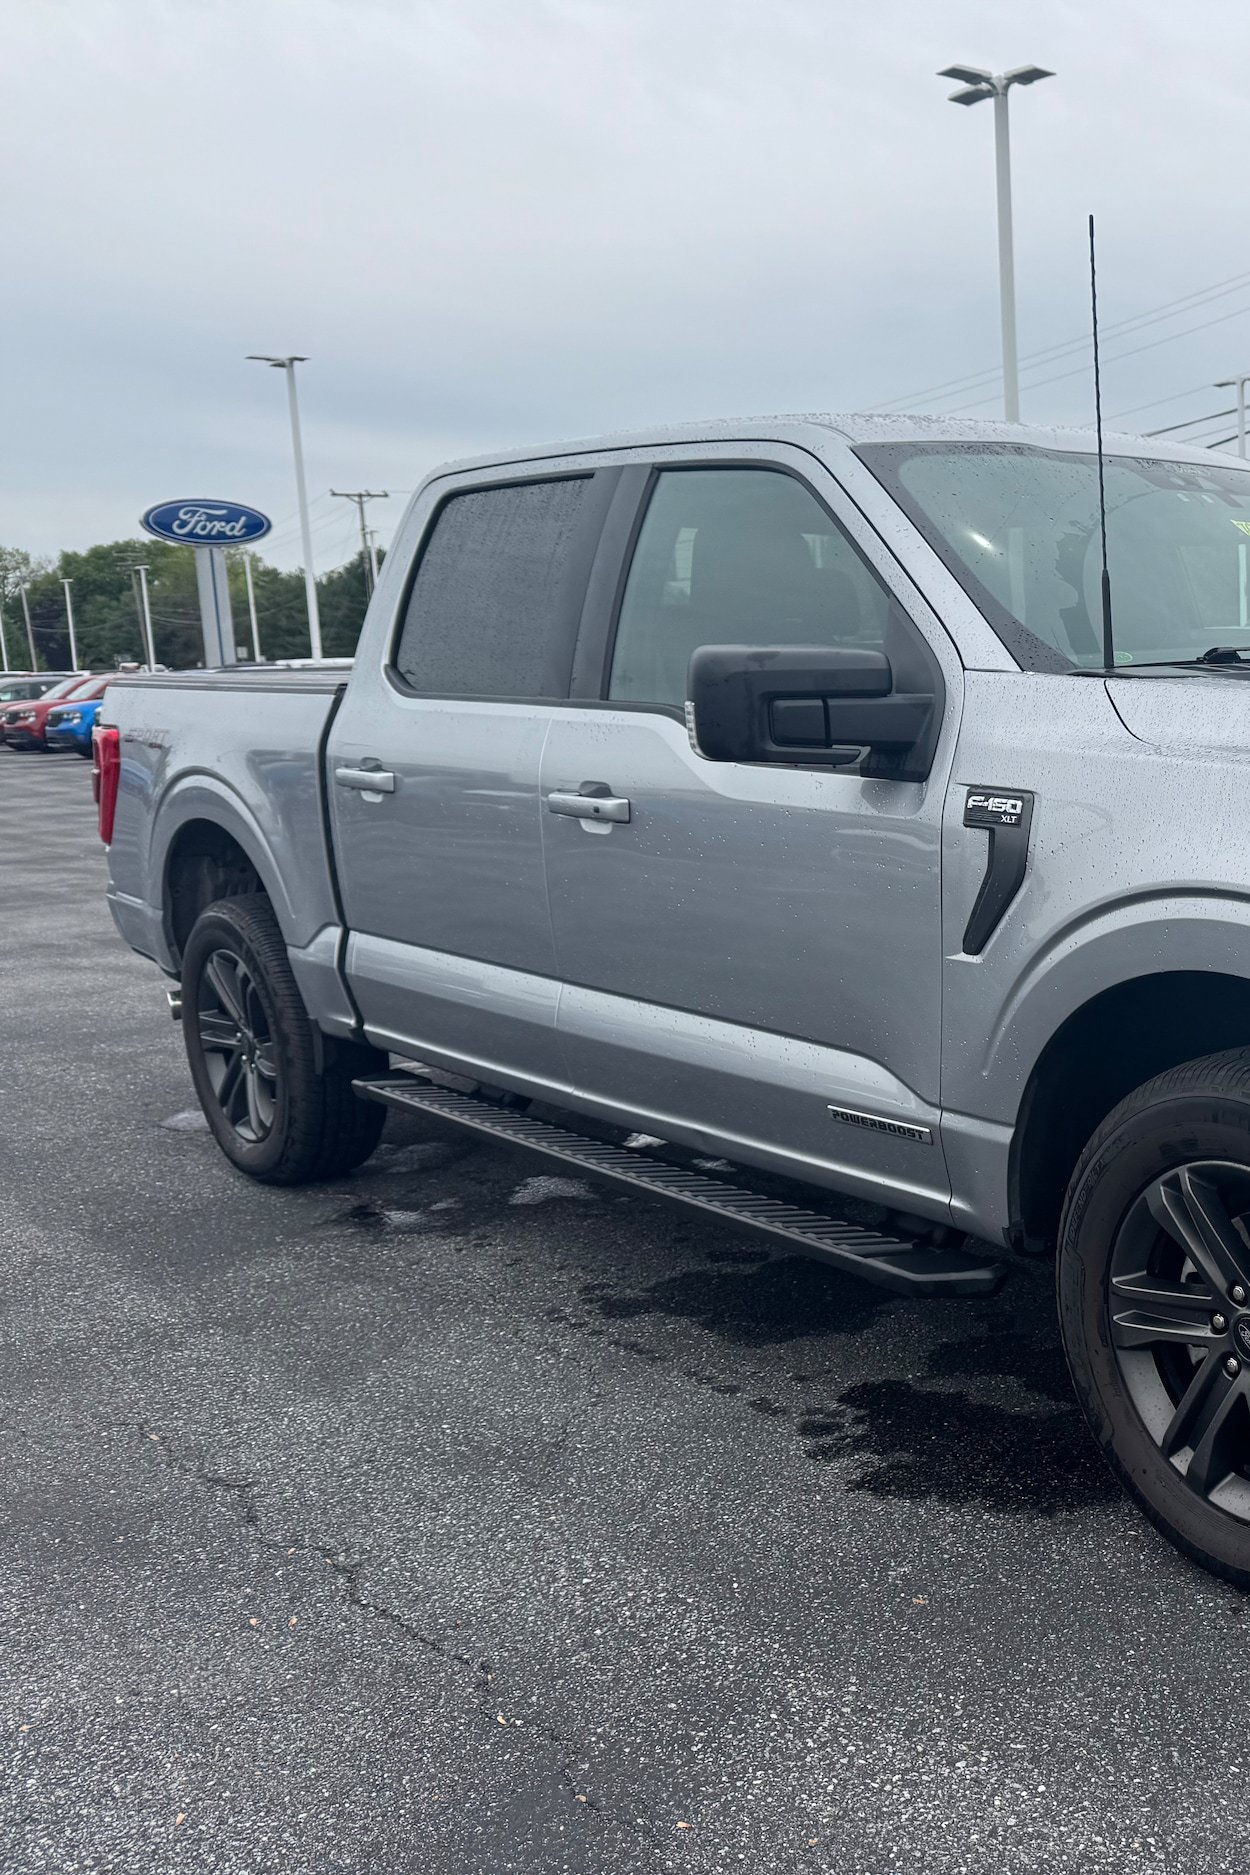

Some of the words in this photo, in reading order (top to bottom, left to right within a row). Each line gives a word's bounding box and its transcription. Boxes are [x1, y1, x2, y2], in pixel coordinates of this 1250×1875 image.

[171, 506, 247, 537] Ford
[967, 796, 1023, 814] F-150
[1000, 815, 1017, 824] XLT
[832, 1110, 924, 1140] POWERBOOST
